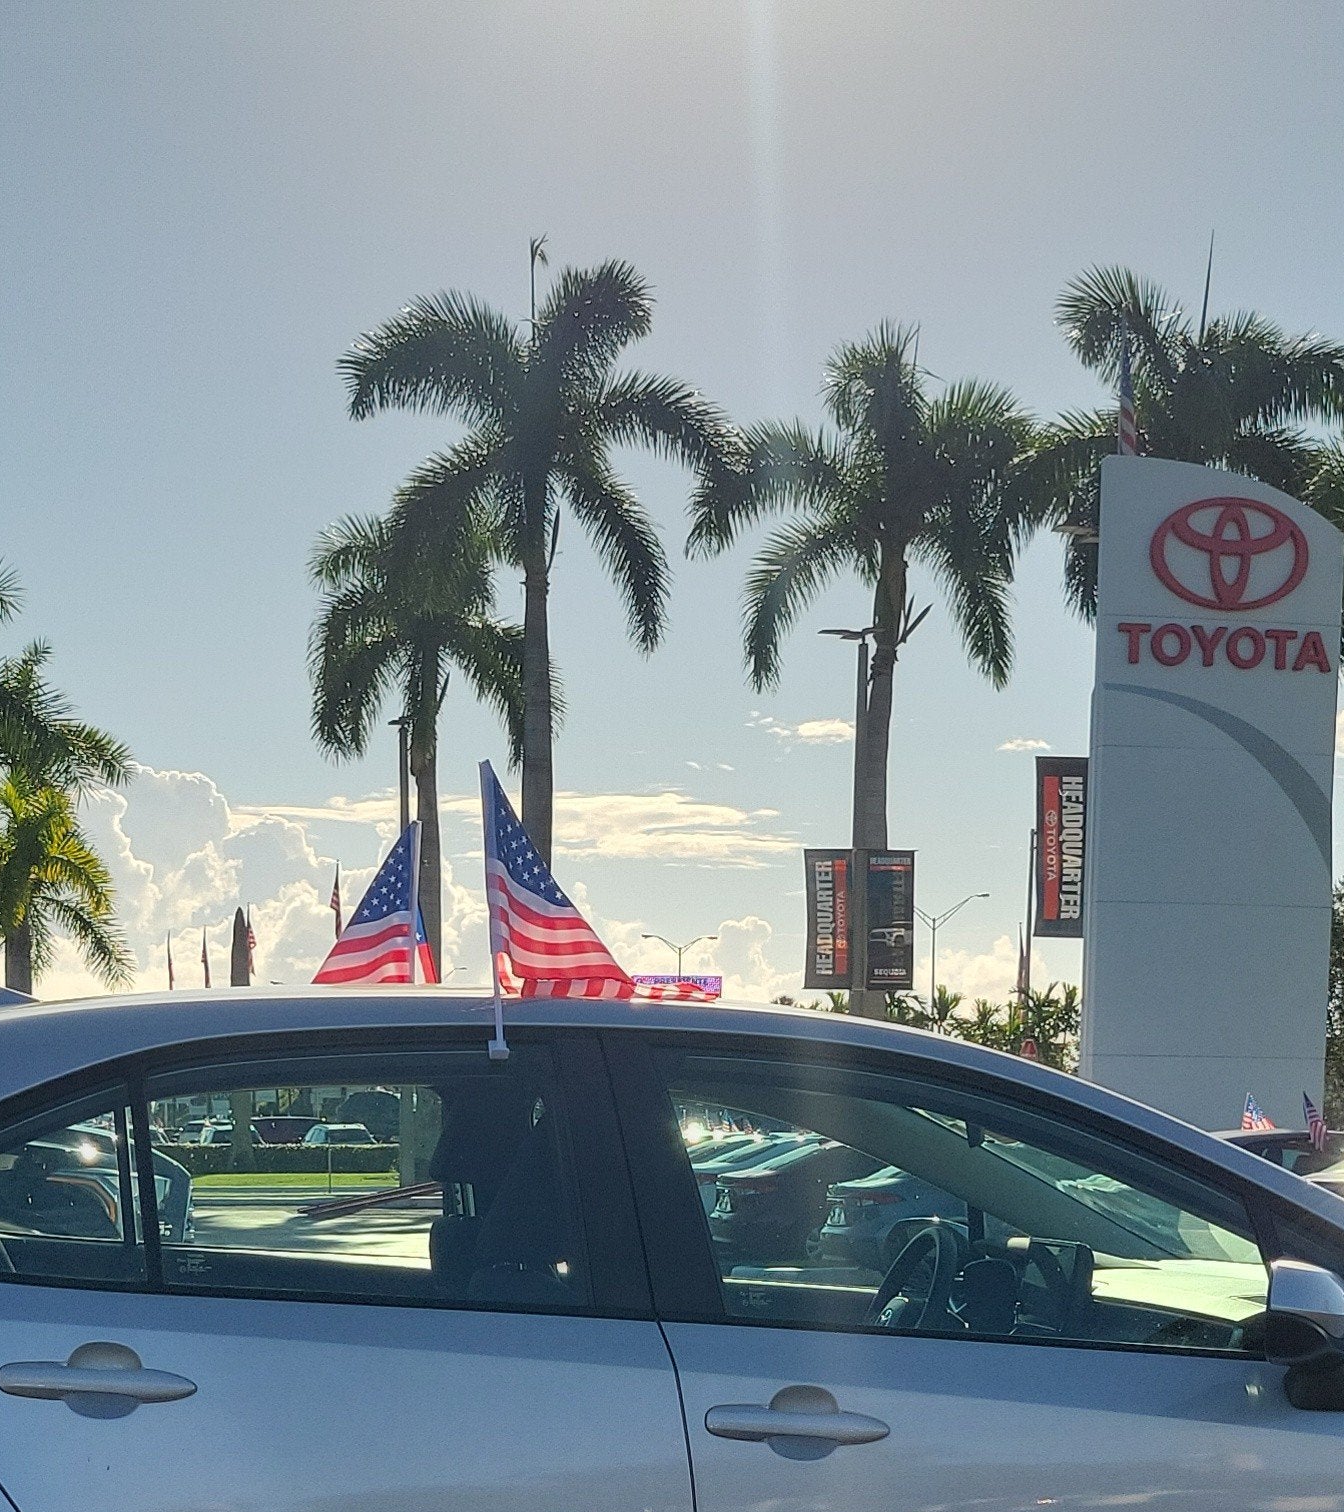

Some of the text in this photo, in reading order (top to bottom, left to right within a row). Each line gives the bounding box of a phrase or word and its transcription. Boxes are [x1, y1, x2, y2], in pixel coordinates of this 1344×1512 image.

[1117, 622, 1331, 674] TOYOTA
[1045, 828, 1057, 881] TOYOTA
[1060, 776, 1084, 919] HEADQUARTER
[815, 860, 834, 975] HEADQUARTER
